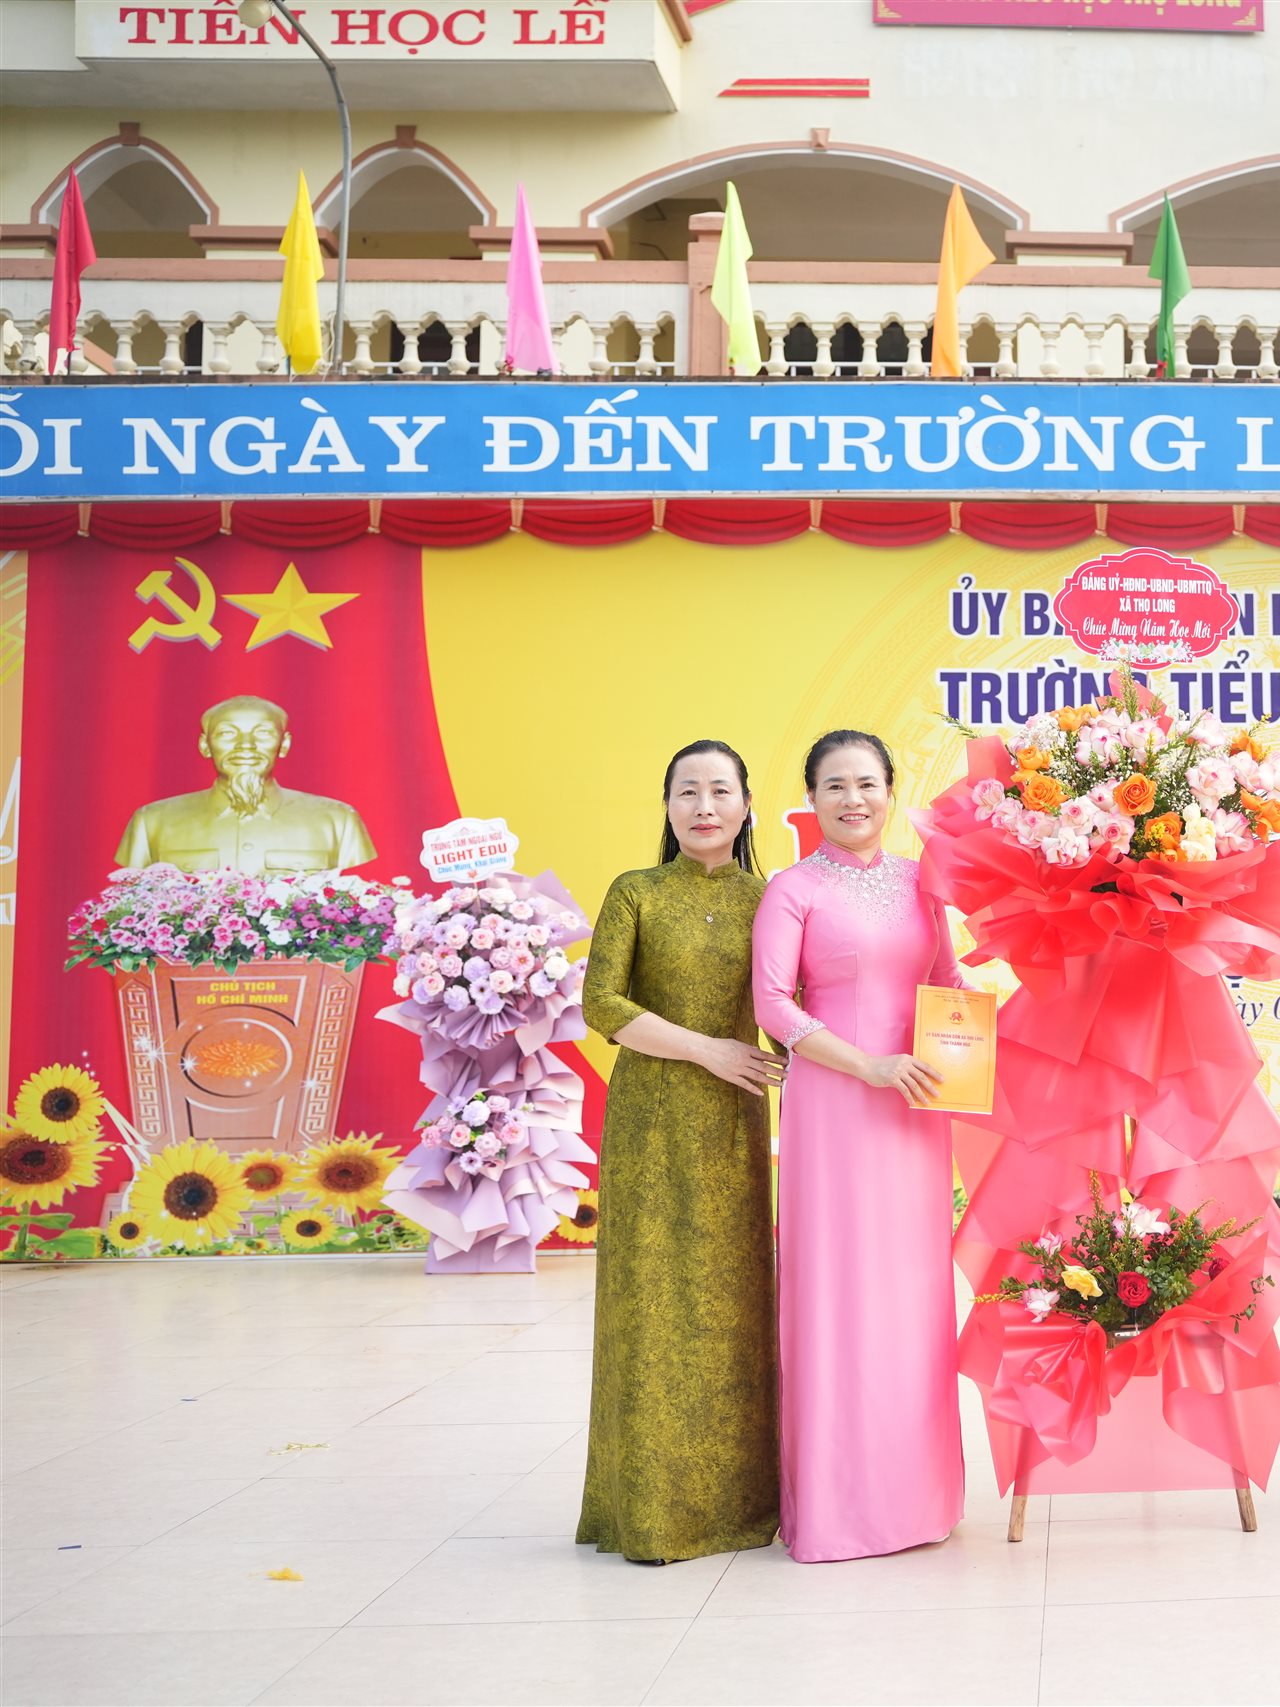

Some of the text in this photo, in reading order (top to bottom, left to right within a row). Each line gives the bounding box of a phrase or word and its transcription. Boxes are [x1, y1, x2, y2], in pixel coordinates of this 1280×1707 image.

[330, 8, 486, 55] HỌC
[122, 397, 446, 475] NGÀY
[483, 390, 718, 474] ĐẾN
[751, 395, 1206, 473] TRƯỜNG
[1081, 572, 1107, 591] ĐẢNG
[952, 576, 1007, 636] ỦY
[1119, 595, 1176, 616] XÃ THỌ LONG
[1083, 616, 1107, 636] Chúc
[940, 658, 1149, 724] TRƯỜN
[434, 843, 508, 865] LIGHT EDU
[209, 980, 276, 993] CHỦ TỊCH
[196, 993, 289, 1005] HỒ CHÍ MINH
